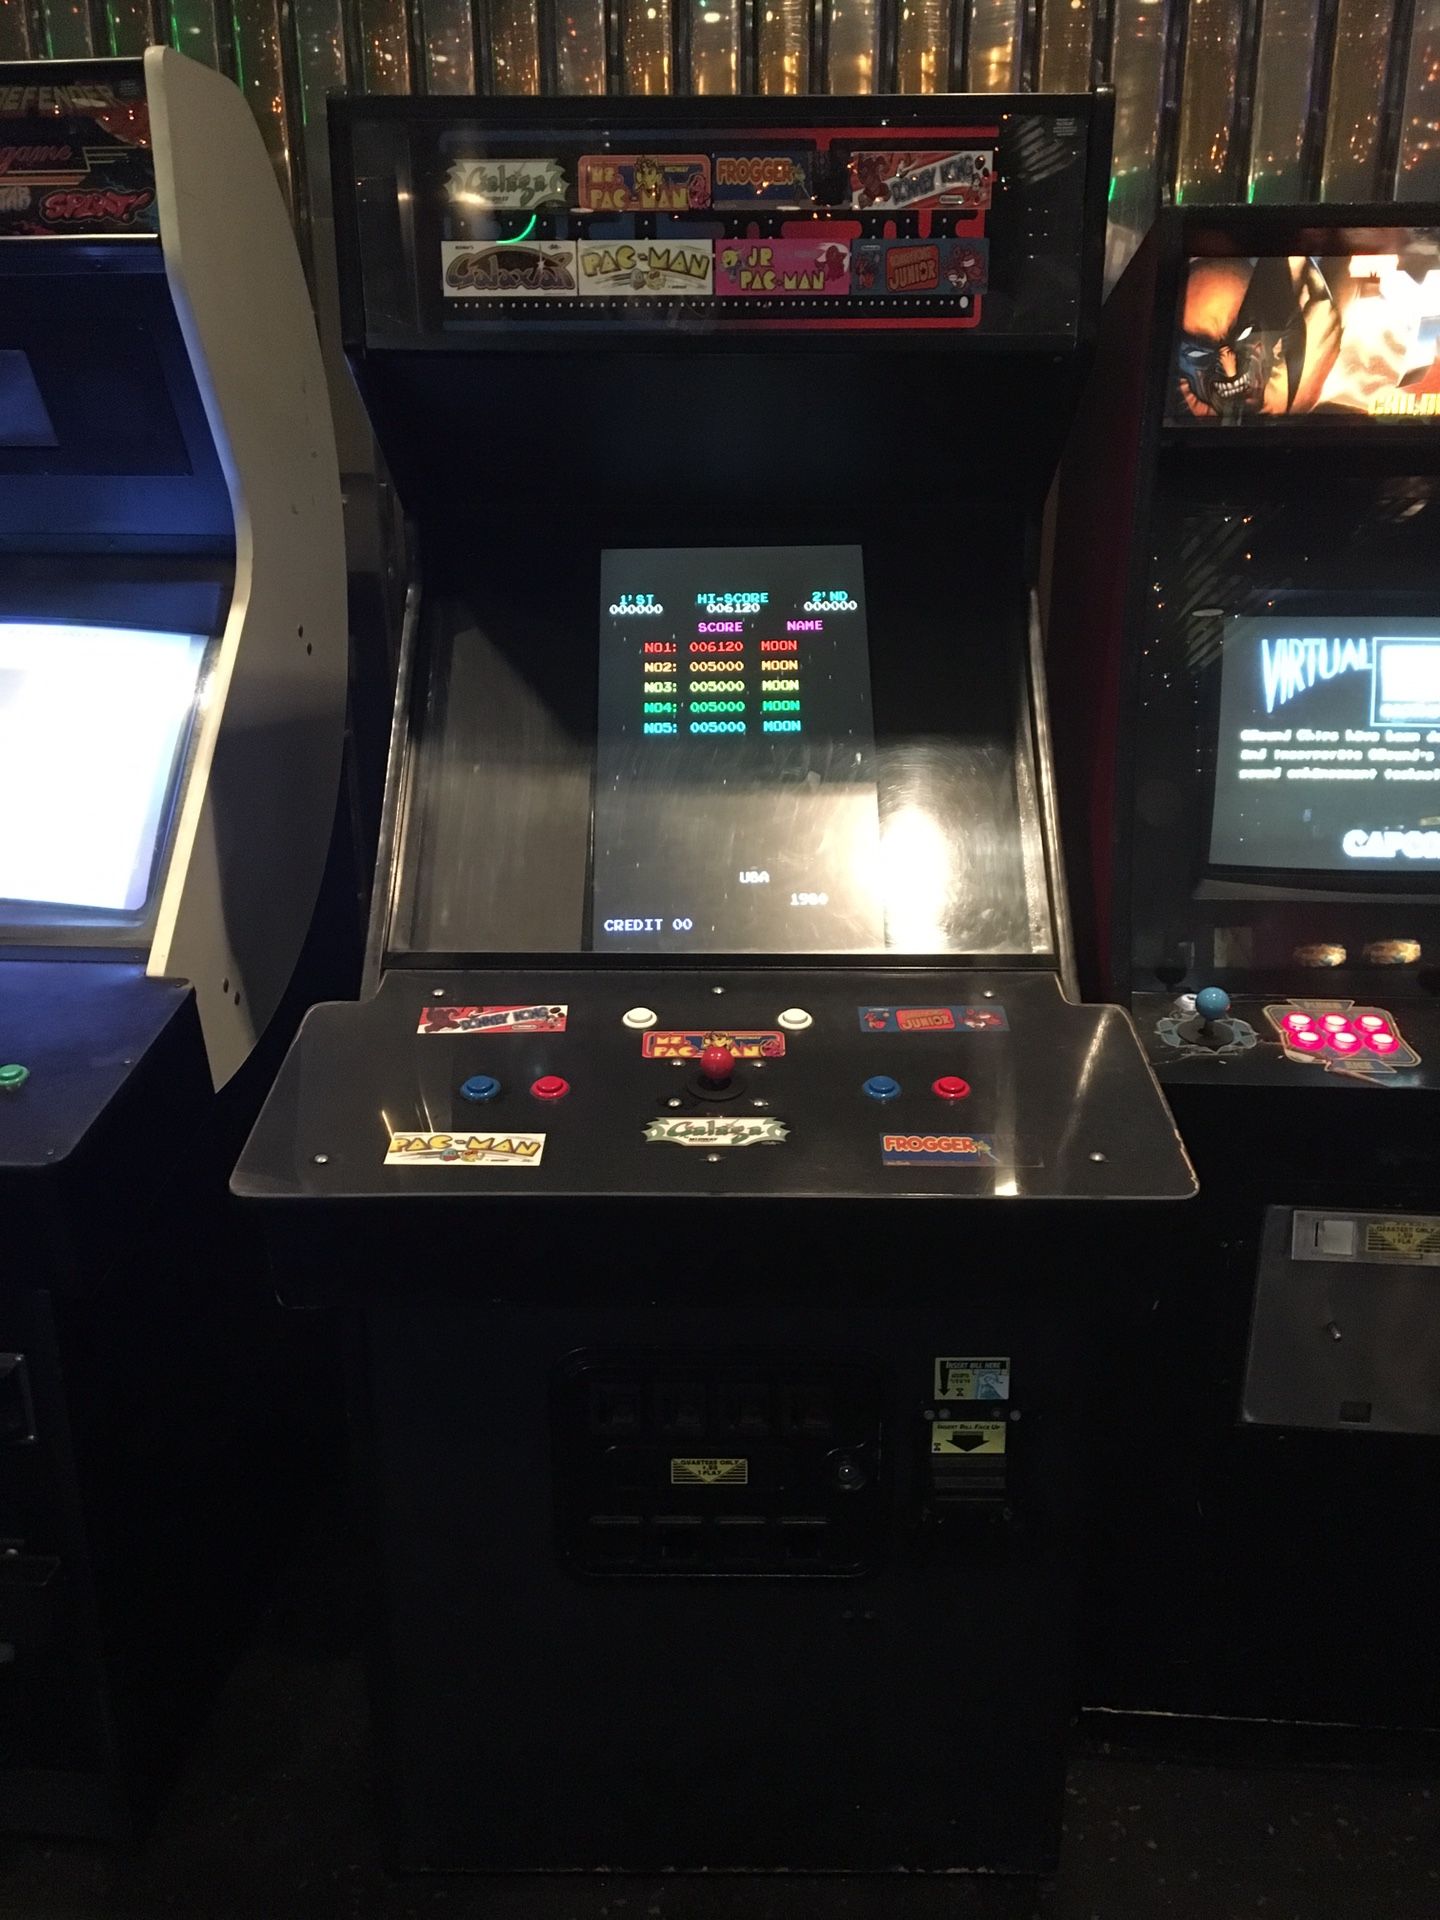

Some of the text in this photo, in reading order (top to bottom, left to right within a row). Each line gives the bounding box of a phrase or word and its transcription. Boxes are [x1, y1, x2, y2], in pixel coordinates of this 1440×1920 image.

[716, 157, 794, 185] FROGGER
[590, 187, 689, 209] PAC-MAN
[581, 244, 711, 281] PAC-MAN
[739, 270, 826, 292] PAC-MAN
[888, 258, 937, 290] JUNIOR
[697, 592, 769, 604] HI-SCORE
[609, 600, 858, 615] 000000 006120 000000
[698, 620, 823, 633] SCORE NAME
[689, 641, 745, 652] 006120
[761, 640, 798, 651] MOON
[689, 661, 745, 672] 005000
[761, 660, 799, 671] MOON
[1261, 637, 1373, 714] VIRTUAL
[689, 681, 745, 692] 005000
[761, 680, 799, 691] MOON
[689, 701, 745, 712] 005000
[762, 700, 800, 712] MOON
[689, 721, 745, 733] 005000
[763, 720, 801, 732] MOON
[603, 918, 693, 932] CREDIT 00
[459, 1007, 549, 1030] DONKEY KONG
[901, 1015, 953, 1030] JUNIOR
[666, 1120, 765, 1145] Galaga
[389, 1134, 542, 1157] PAC-MAN
[884, 1135, 978, 1154] FROGGER
